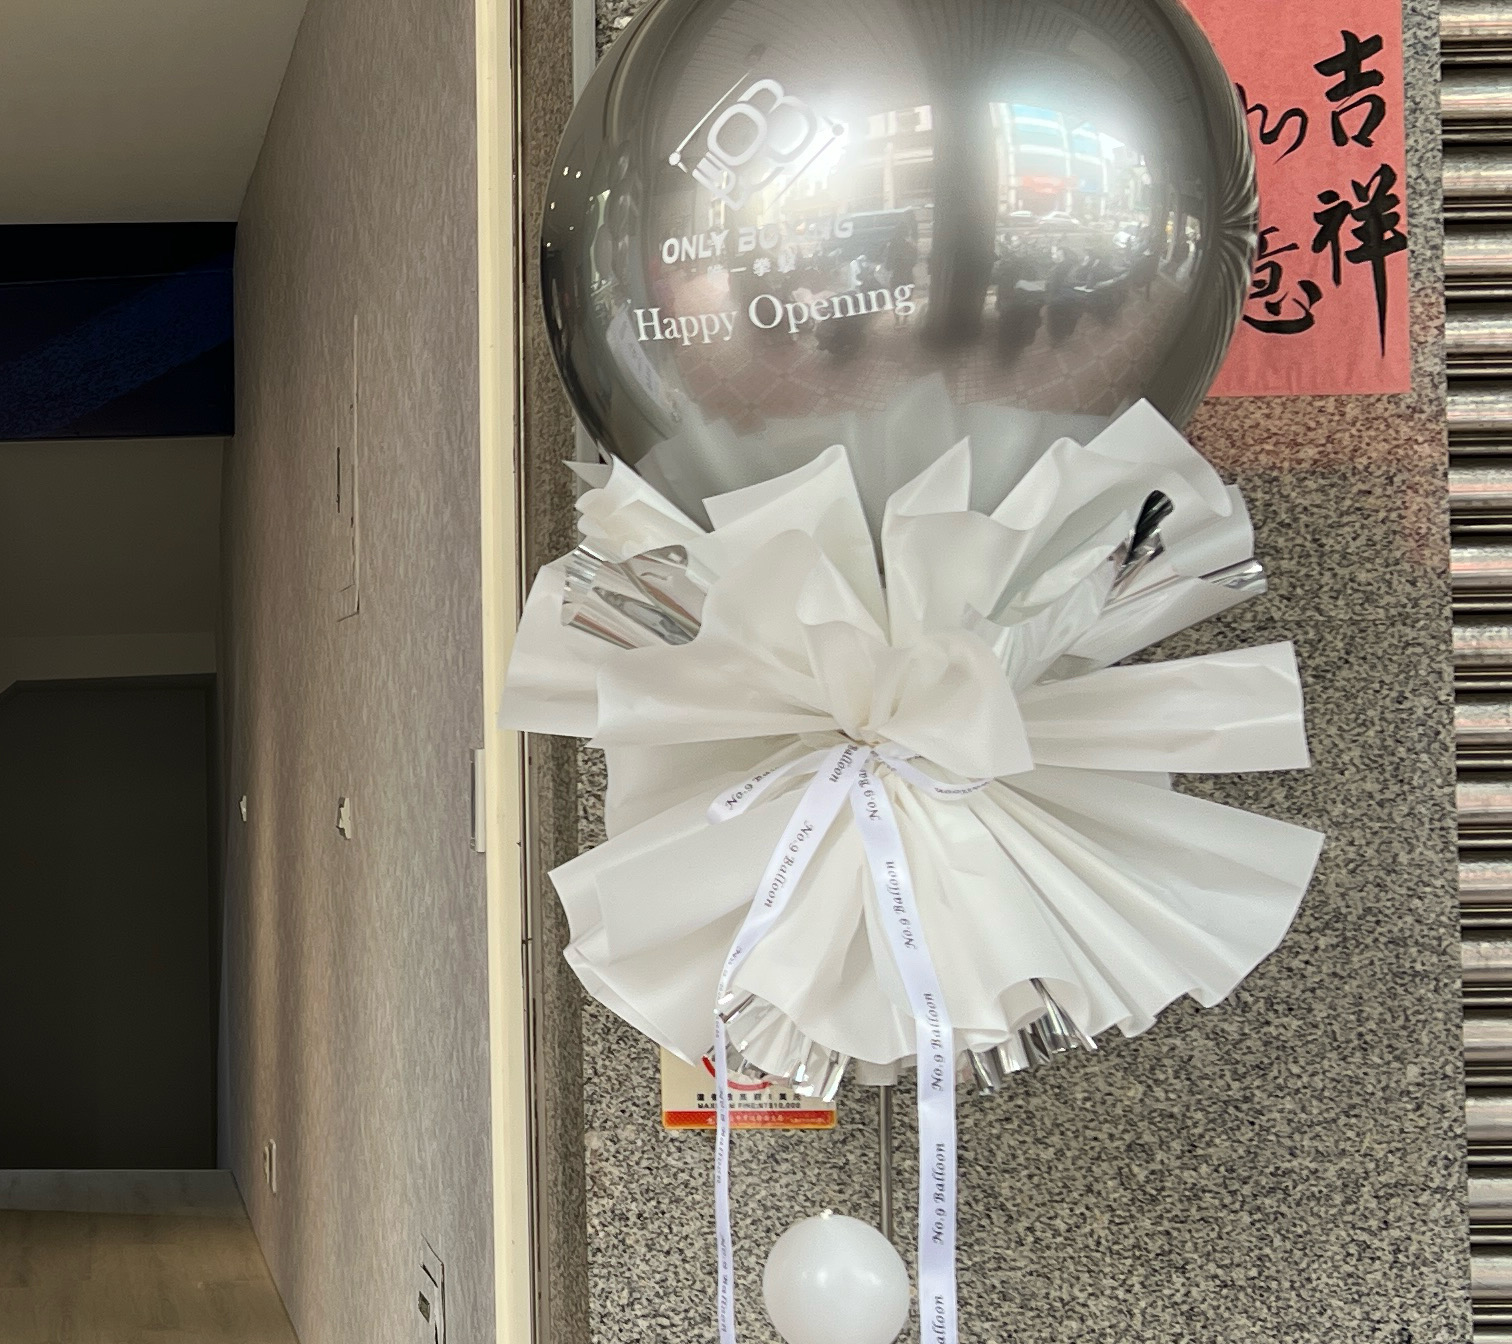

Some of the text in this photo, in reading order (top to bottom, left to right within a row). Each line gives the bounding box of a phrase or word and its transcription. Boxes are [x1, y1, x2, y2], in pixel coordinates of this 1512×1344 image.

[1312, 29, 1408, 359] 吉祥
[661, 229, 730, 265] ONLY
[633, 284, 916, 346] Happy Opening
[764, 819, 816, 908] No.9 Balloon
[885, 861, 907, 914] Balloon
[924, 993, 943, 1050] Balloon
[931, 1143, 946, 1203] Balloon
